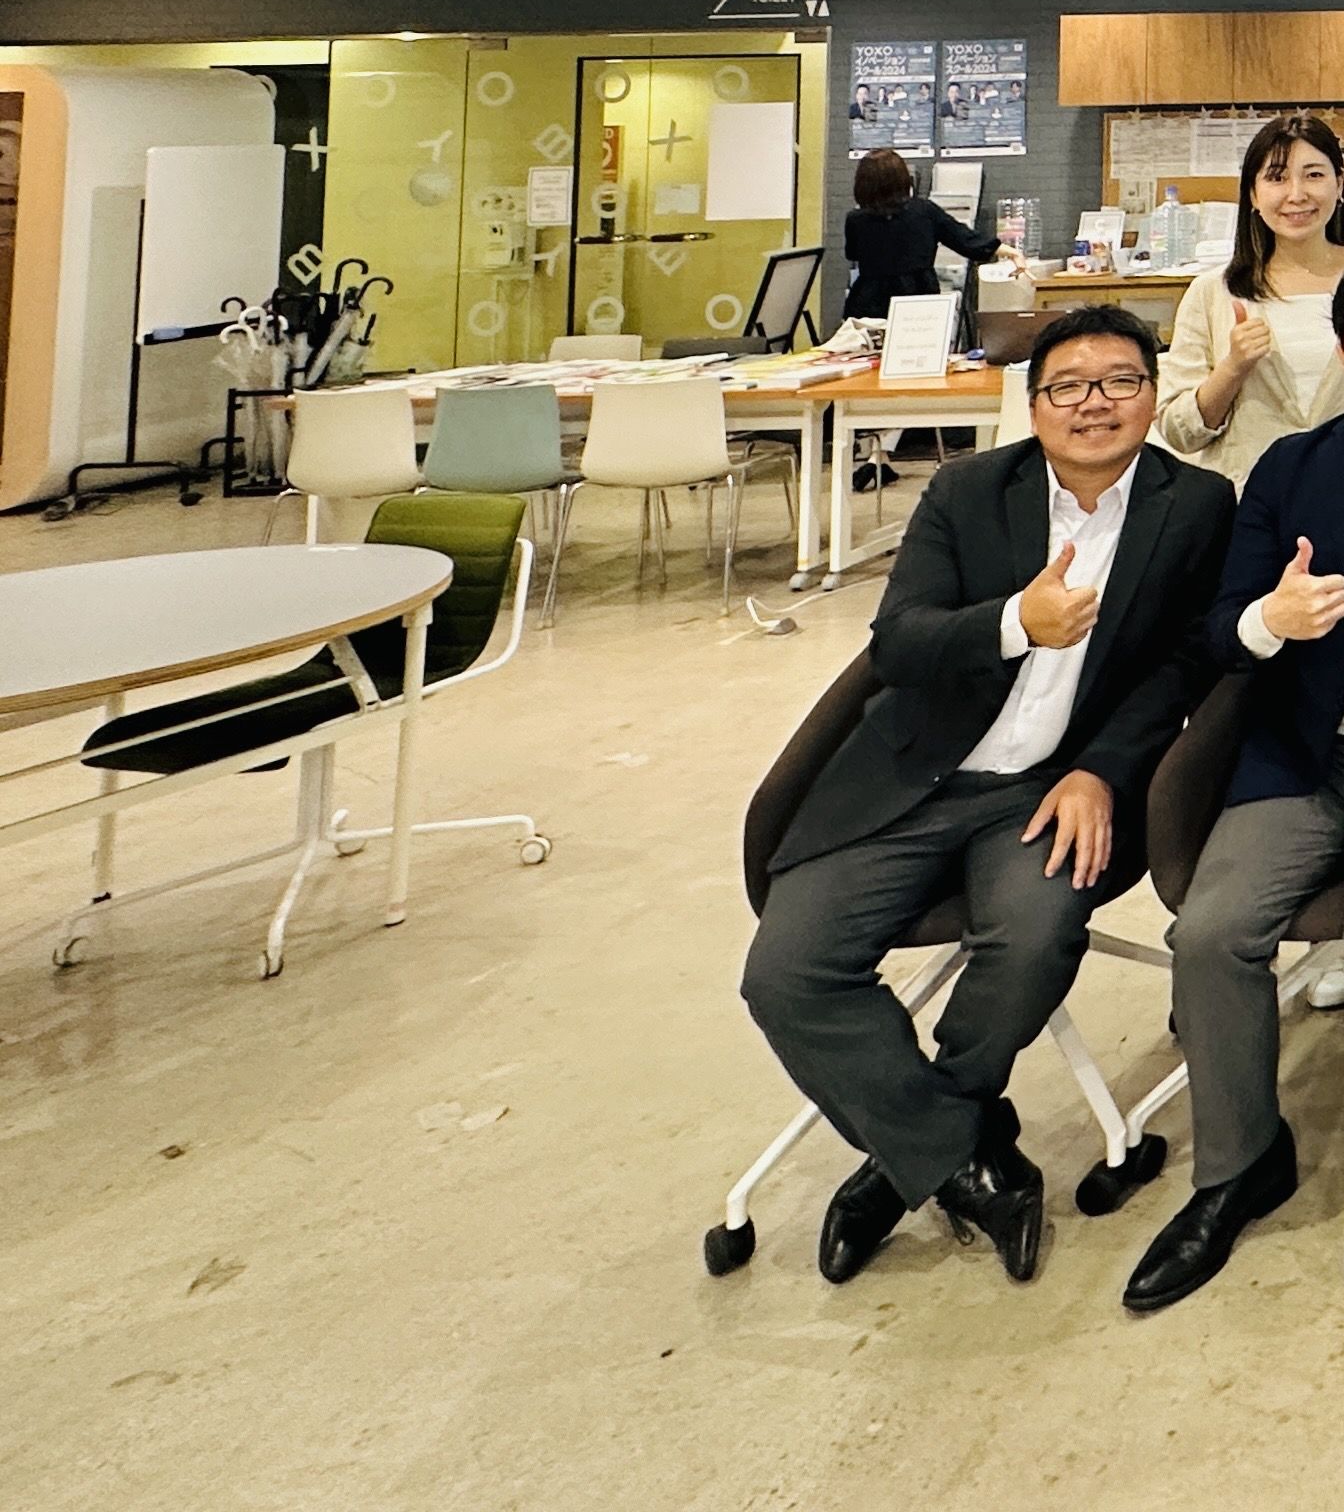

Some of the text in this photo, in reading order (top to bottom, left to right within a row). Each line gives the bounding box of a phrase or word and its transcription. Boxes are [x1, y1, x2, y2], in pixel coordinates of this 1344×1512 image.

[855, 46, 894, 57] YOXO
[946, 44, 984, 55] YOXO
[855, 56, 907, 66] イノベーション
[946, 54, 997, 65] イノベーション
